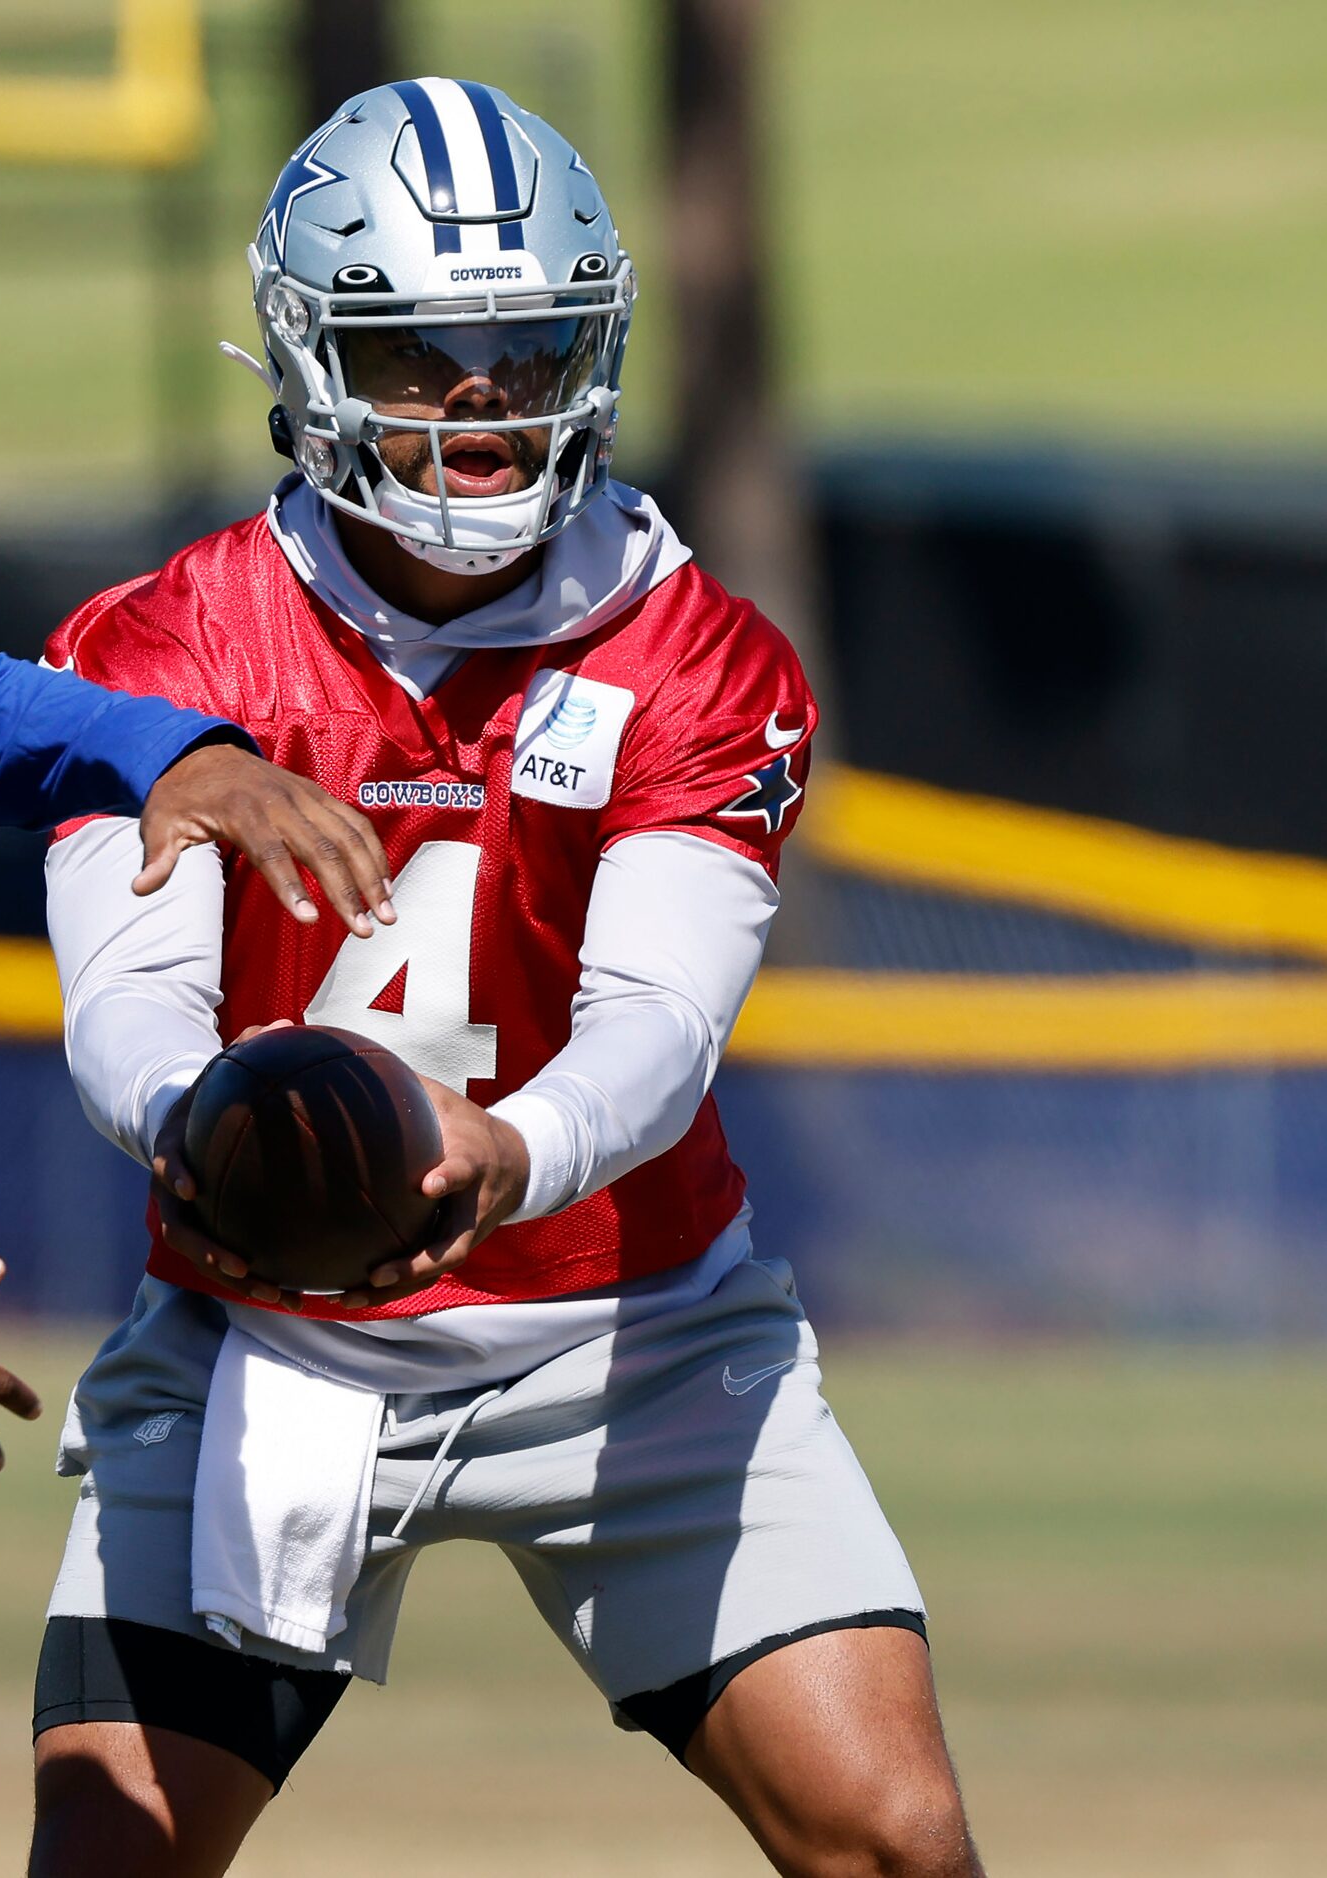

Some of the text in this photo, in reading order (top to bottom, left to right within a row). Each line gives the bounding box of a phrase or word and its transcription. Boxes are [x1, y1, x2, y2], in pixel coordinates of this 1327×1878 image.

[450, 265, 522, 281] COWBOYS
[520, 754, 586, 791] AT&T
[359, 782, 485, 808] COWBOYS
[303, 840, 498, 1097] 4
